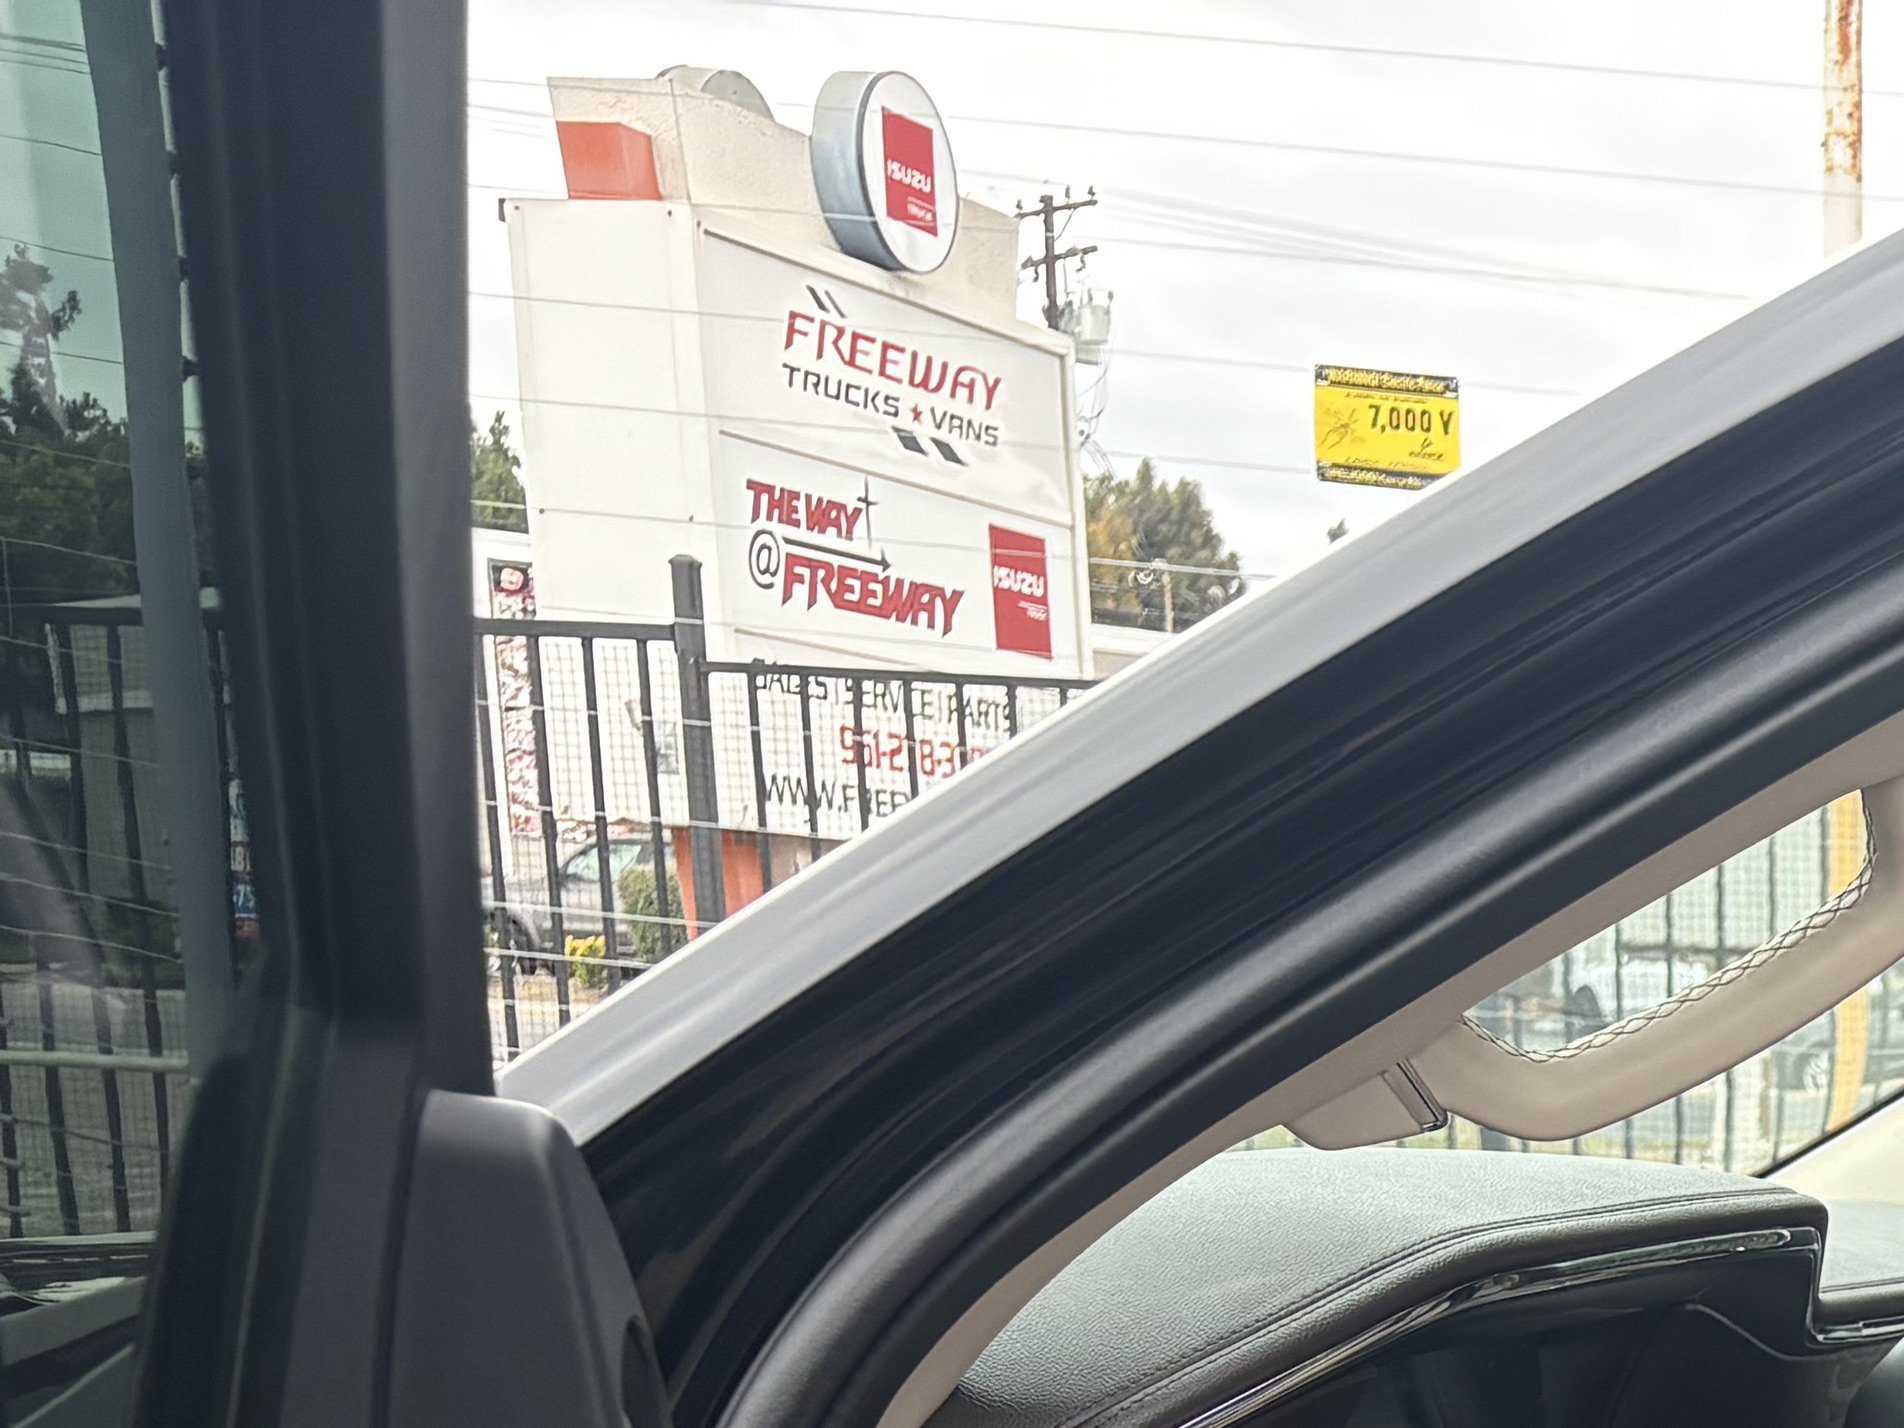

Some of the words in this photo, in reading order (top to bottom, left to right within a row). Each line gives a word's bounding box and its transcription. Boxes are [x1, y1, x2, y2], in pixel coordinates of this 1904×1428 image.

[887, 159, 931, 192] ISUZU
[784, 310, 1001, 410] FREEWAY
[782, 362, 900, 417] TRUCKS
[930, 406, 999, 447] VANS
[1368, 404, 1432, 434] 7,000
[1439, 409, 1454, 435] V
[747, 478, 801, 528] THE
[805, 493, 863, 541] WAY
[749, 529, 780, 589] @
[781, 551, 965, 638] FREEWAY
[993, 565, 1045, 597] ISUZU
